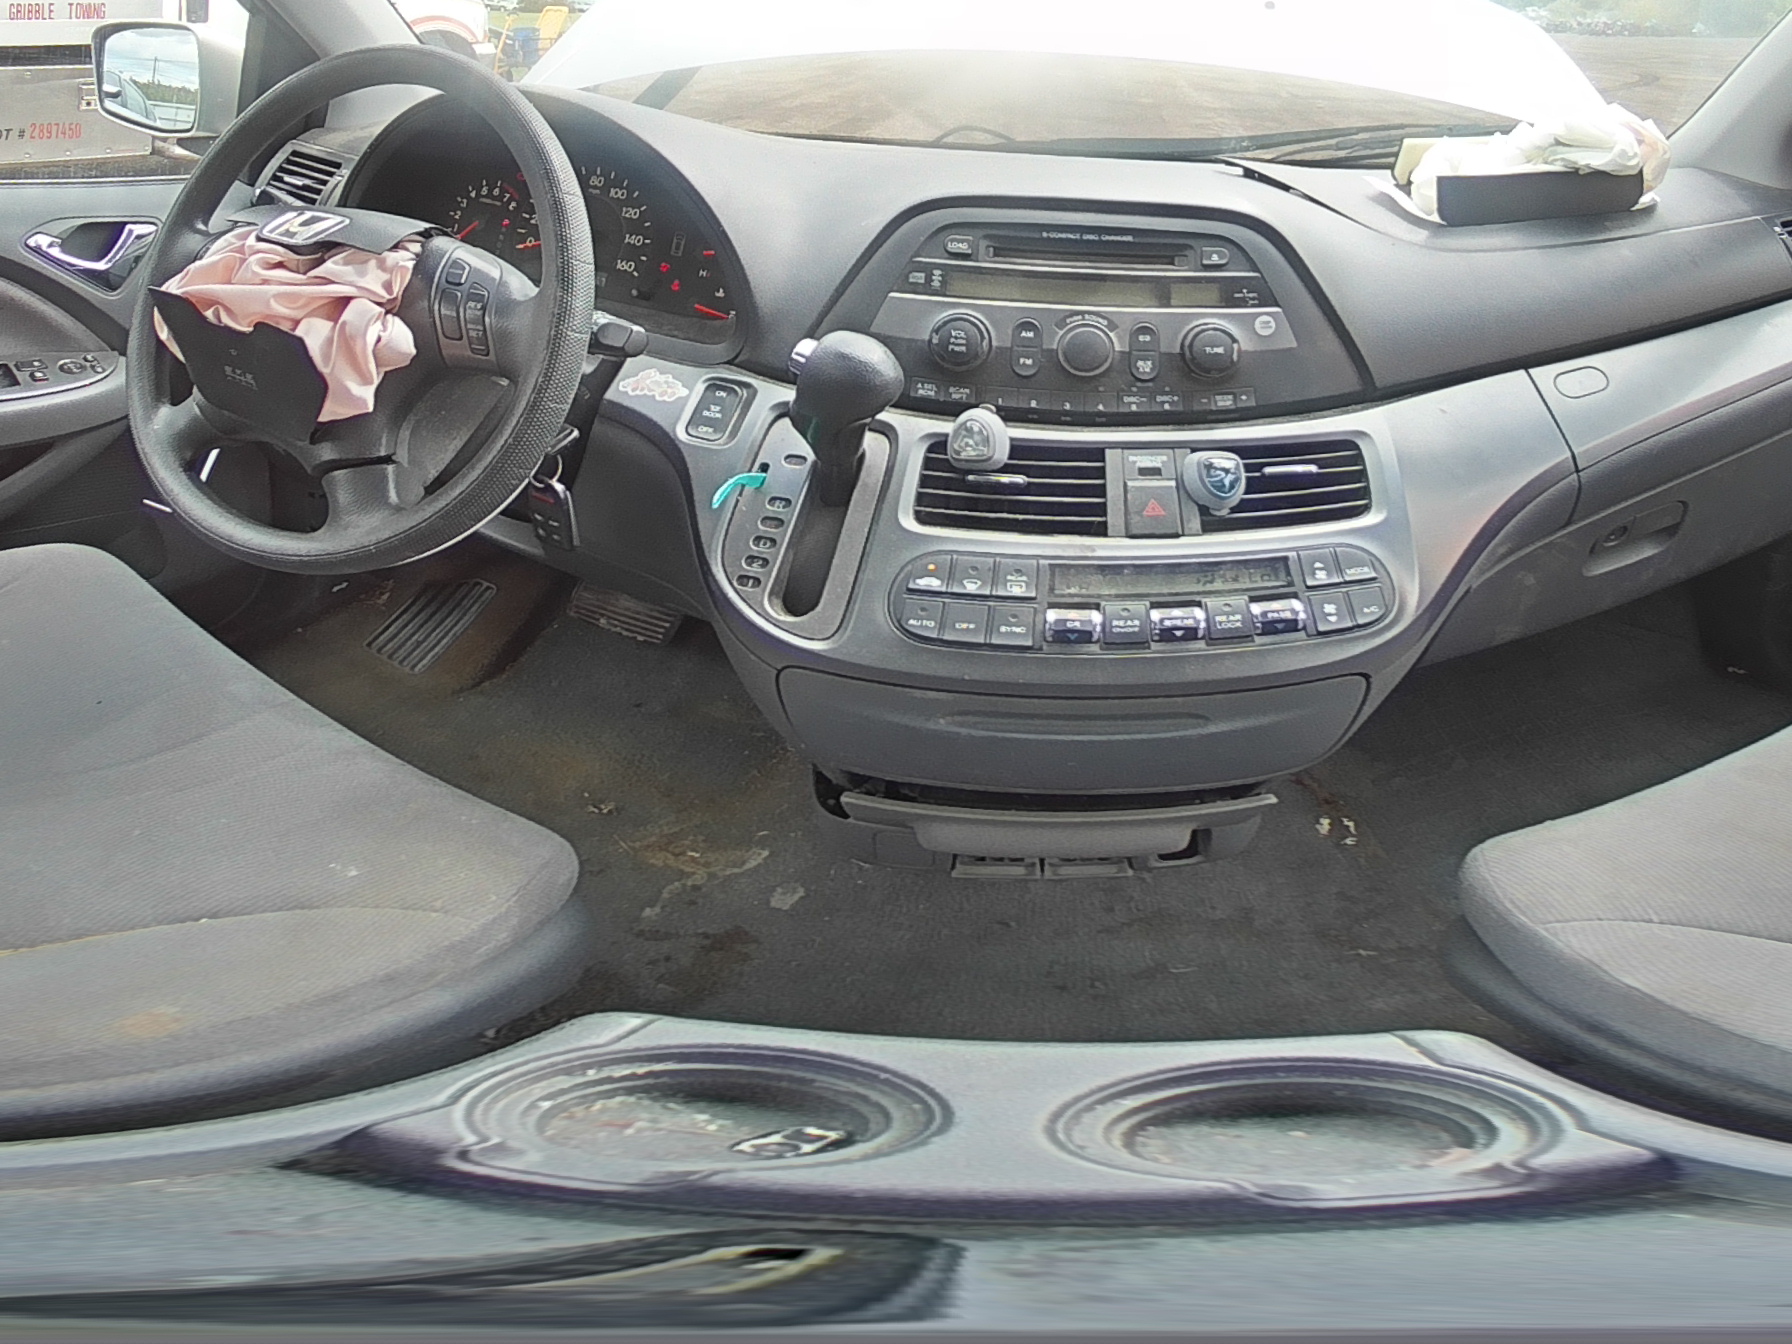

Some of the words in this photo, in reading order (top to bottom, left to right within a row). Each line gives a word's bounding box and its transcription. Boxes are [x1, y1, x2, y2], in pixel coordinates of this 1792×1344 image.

[8, 3, 55, 21] GRIBBLE
[68, 2, 107, 20] TOWING
[18, 129, 26, 140] #
[29, 122, 82, 140] 2897450
[589, 176, 605, 187] 80
[609, 188, 627, 200] 100
[621, 207, 640, 219] 120
[624, 234, 643, 246] 140
[947, 241, 969, 250] LOAD
[616, 260, 635, 272] 160
[950, 328, 967, 339] VOL
[1020, 329, 1035, 338] AM
[1204, 346, 1225, 355] TUNE
[1019, 357, 1034, 367] FM
[715, 390, 728, 398] ON
[1030, 399, 1039, 408] 2
[1063, 402, 1071, 410] 3
[1096, 402, 1105, 411] 4
[702, 410, 723, 419] DOOR
[697, 425, 715, 434] OFF
[1362, 604, 1379, 613] A/C
[1215, 614, 1242, 623] REAR
[1266, 610, 1293, 620] PASS
[908, 618, 935, 628] AUTO
[955, 622, 976, 630] OFF
[1112, 619, 1141, 628] REAR
[1216, 621, 1243, 630] LOCK
[999, 625, 1027, 634] SYNC
